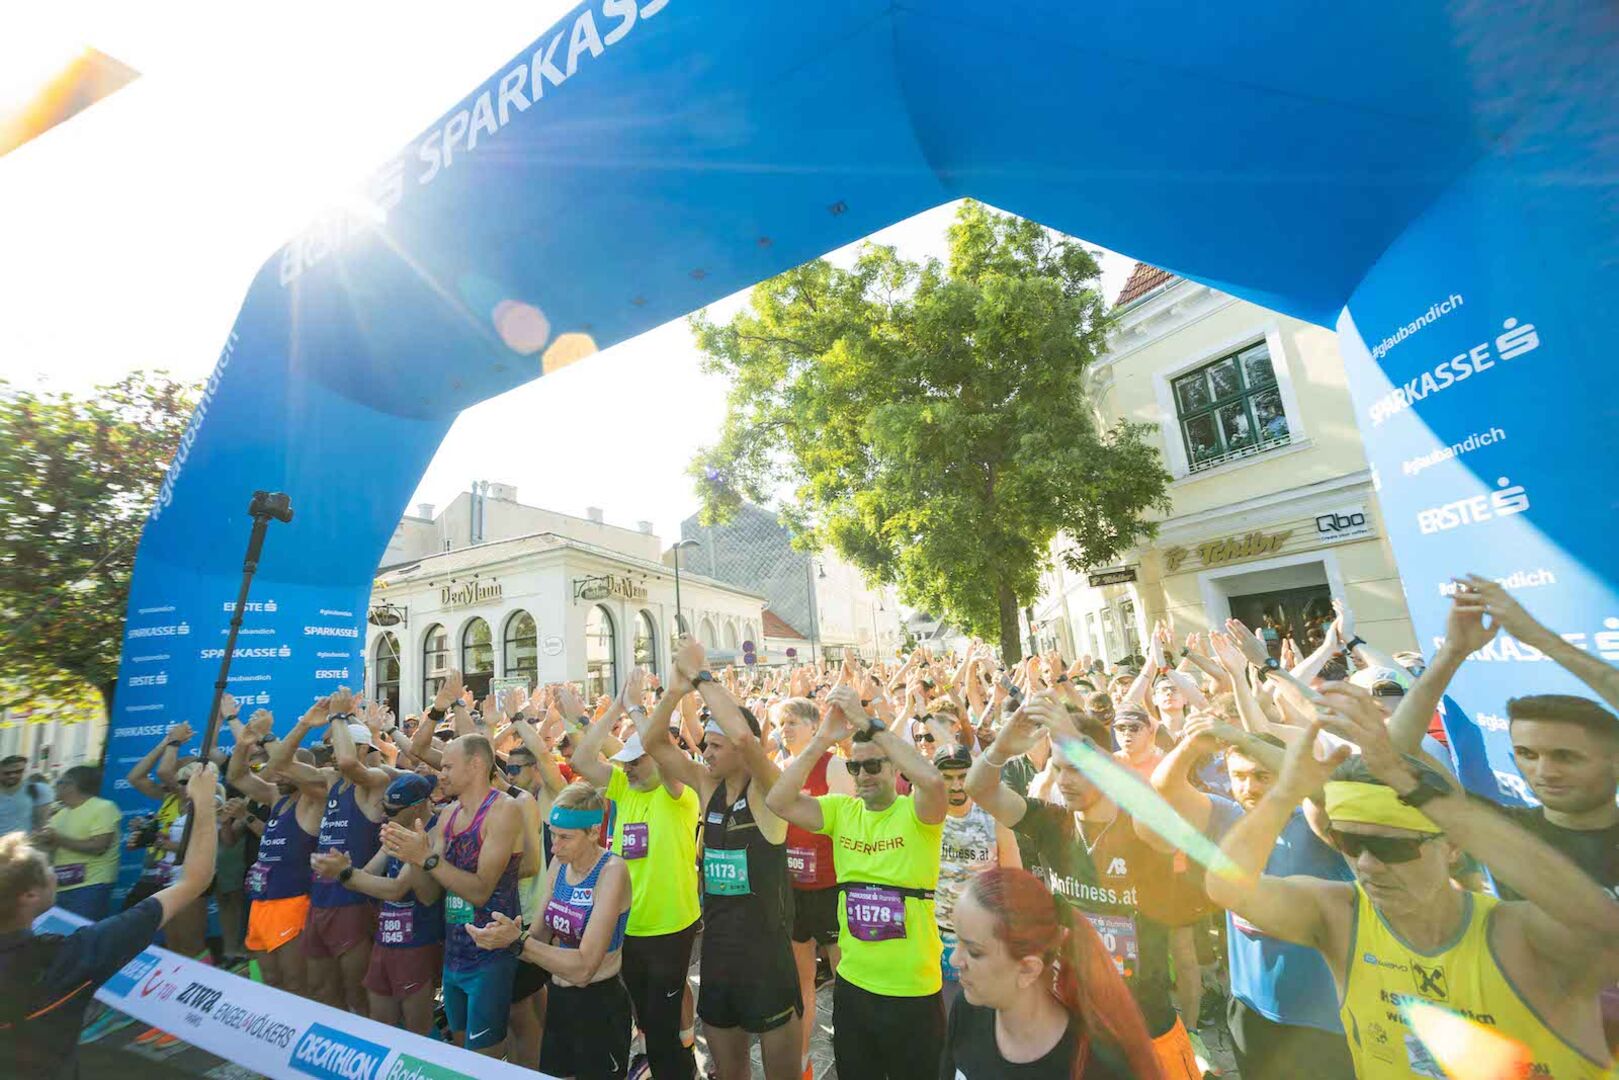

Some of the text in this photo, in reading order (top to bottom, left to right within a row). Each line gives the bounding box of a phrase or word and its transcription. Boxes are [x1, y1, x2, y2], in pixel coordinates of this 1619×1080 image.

[1372, 294, 1464, 359] #glaubandich
[1369, 342, 1497, 427] SPARKASSE
[1315, 513, 1365, 532] Qbo
[1417, 494, 1493, 535] ERSTE
[304, 626, 353, 637] SPARKASSE
[315, 670, 341, 678] ERSTE
[709, 862, 736, 878] 1173
[854, 904, 891, 922] 1578
[553, 915, 570, 934] 623
[296, 1033, 379, 1080] DECATHLON
